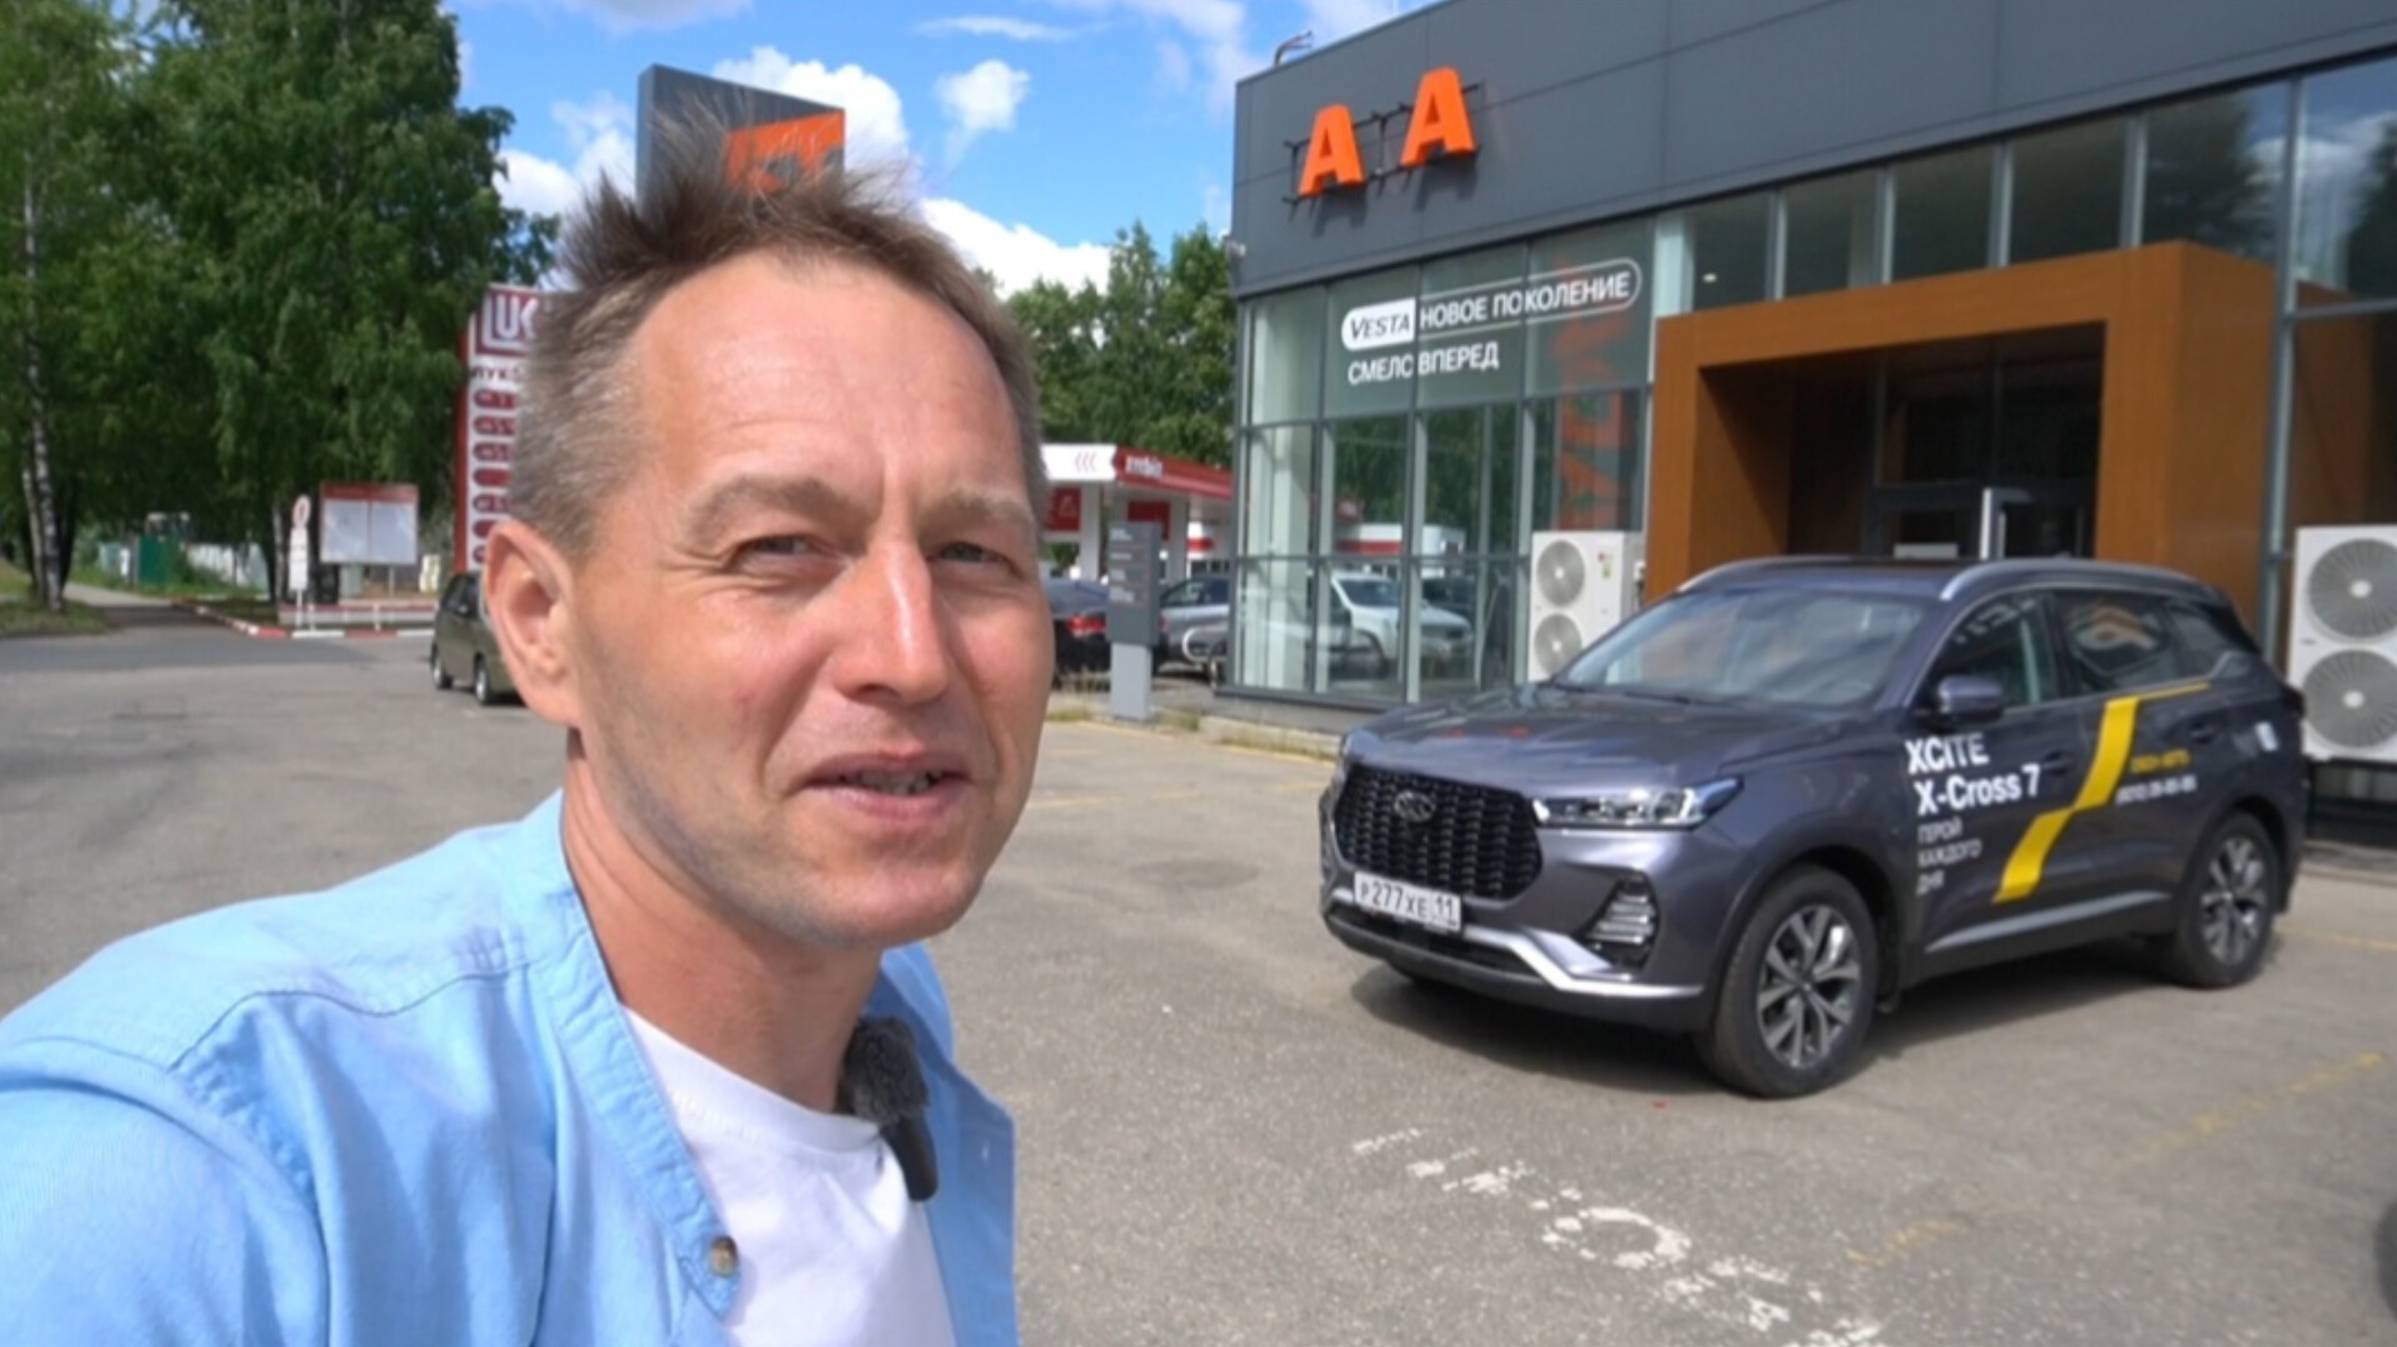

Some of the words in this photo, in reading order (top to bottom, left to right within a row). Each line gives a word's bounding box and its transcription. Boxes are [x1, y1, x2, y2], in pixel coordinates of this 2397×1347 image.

[1419, 300, 1487, 330] НОВОЕ
[1493, 270, 1631, 316] ПОКОЛЕНИЕ
[1350, 311, 1410, 341] VESTA
[1417, 341, 1499, 376] ВПЕРЕД
[1905, 732, 1989, 774] XCITE
[1913, 773, 2022, 817] X-Cross
[2021, 763, 2040, 797] 7
[1917, 816, 1963, 844] ГЕРОЙ
[1917, 838, 1983, 868] КАЖДОГО
